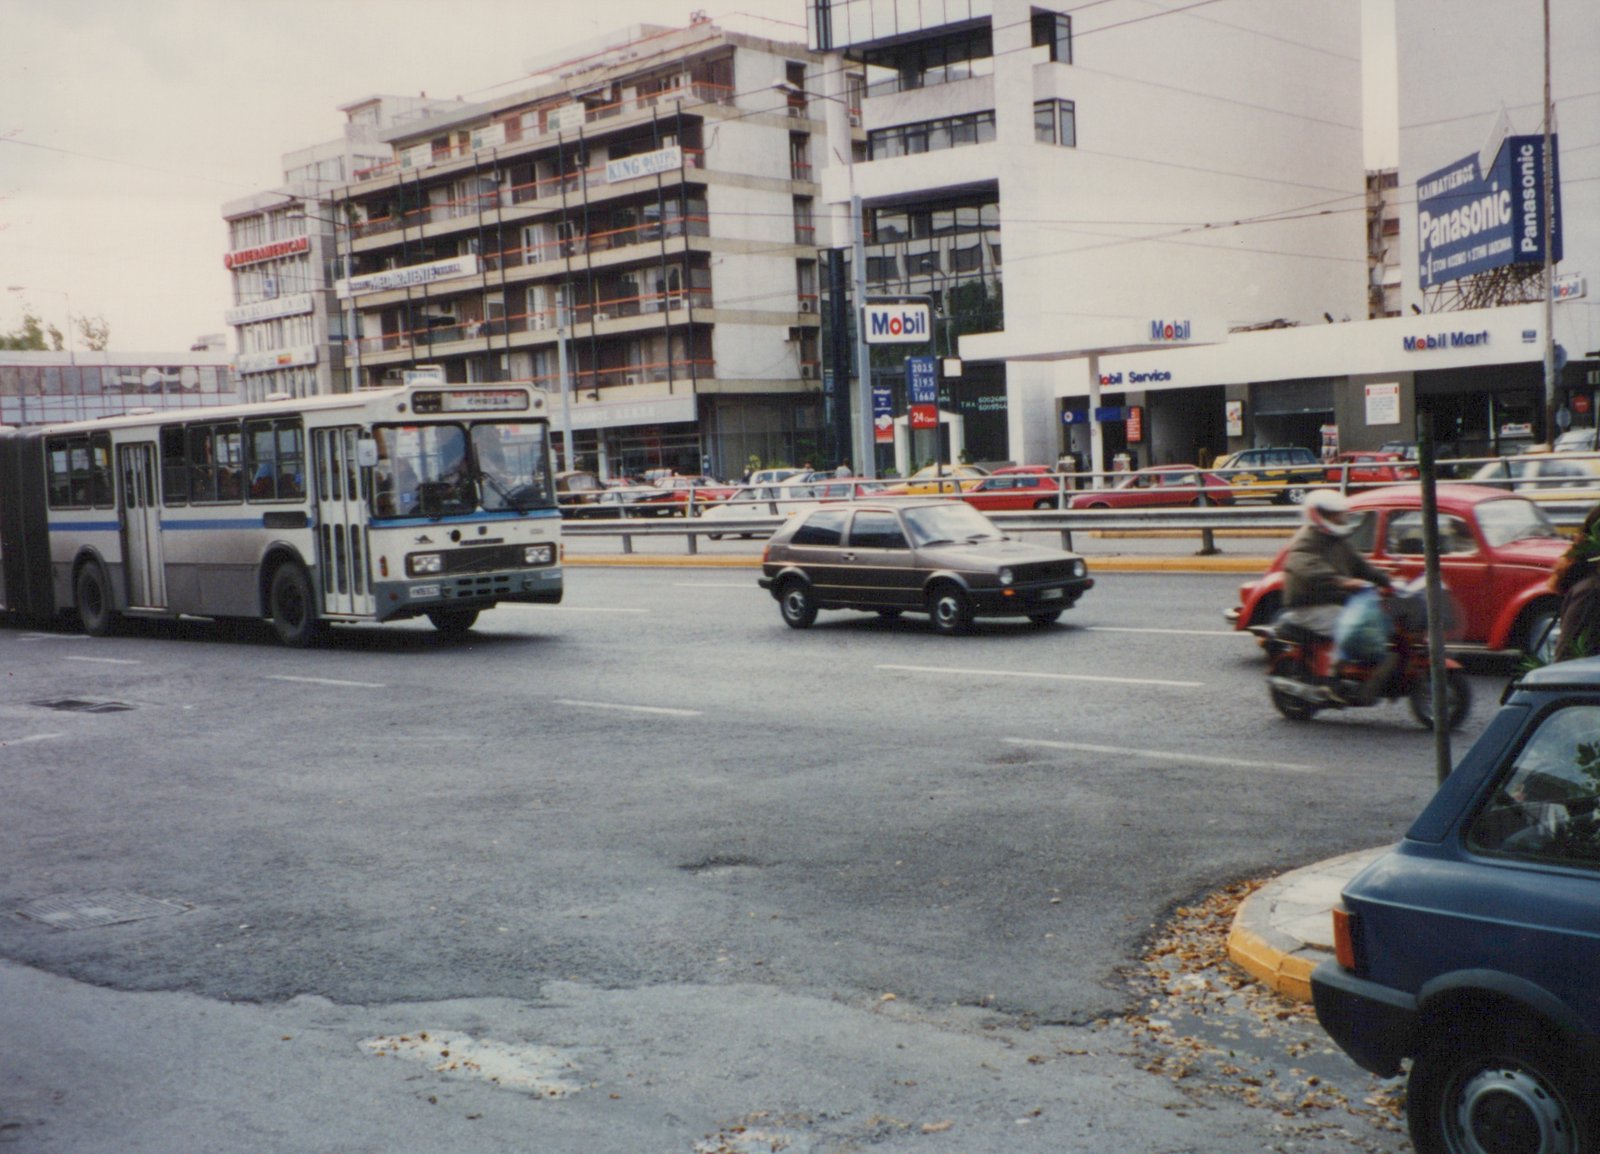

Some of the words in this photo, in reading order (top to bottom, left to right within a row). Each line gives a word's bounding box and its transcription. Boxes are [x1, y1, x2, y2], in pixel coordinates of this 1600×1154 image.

[1518, 143, 1539, 253] Panasonic
[1419, 180, 1512, 253] Panasonic
[234, 236, 308, 265] INTERAMERICAN
[1552, 280, 1579, 299] Mobil
[871, 311, 926, 337] Mobil
[1150, 320, 1191, 341] Mobil
[1403, 333, 1447, 352] Mobil
[1450, 329, 1489, 347] Mart
[1128, 370, 1172, 384] Service
[912, 412, 924, 424] 24
